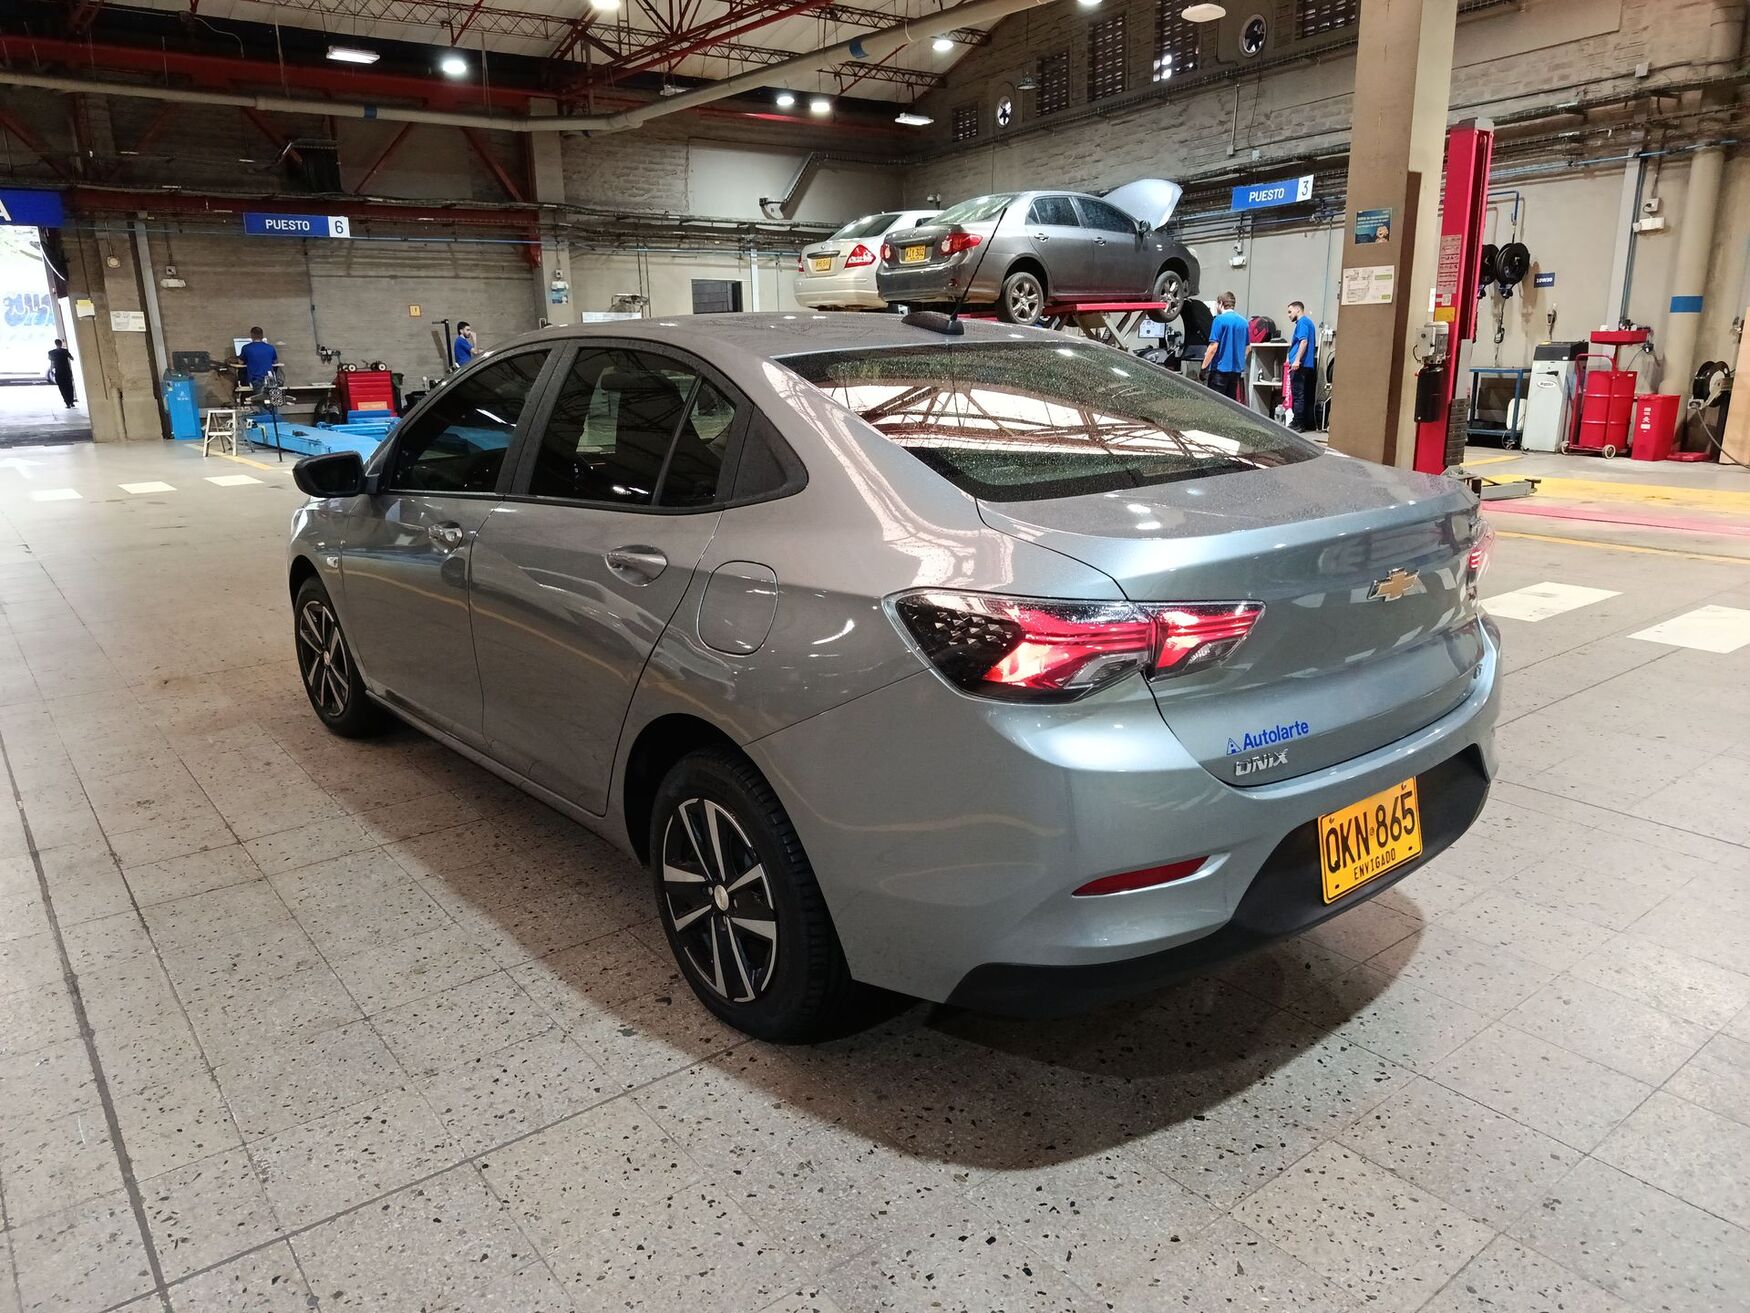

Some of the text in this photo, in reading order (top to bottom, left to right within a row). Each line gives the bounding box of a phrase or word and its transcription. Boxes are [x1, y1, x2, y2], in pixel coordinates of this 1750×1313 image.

[1248, 180, 1309, 203] PUESTO 3
[265, 219, 344, 234] PUESTO 6
[1243, 720, 1309, 751] Autolarte
[1353, 847, 1396, 880] ENVIGADO
